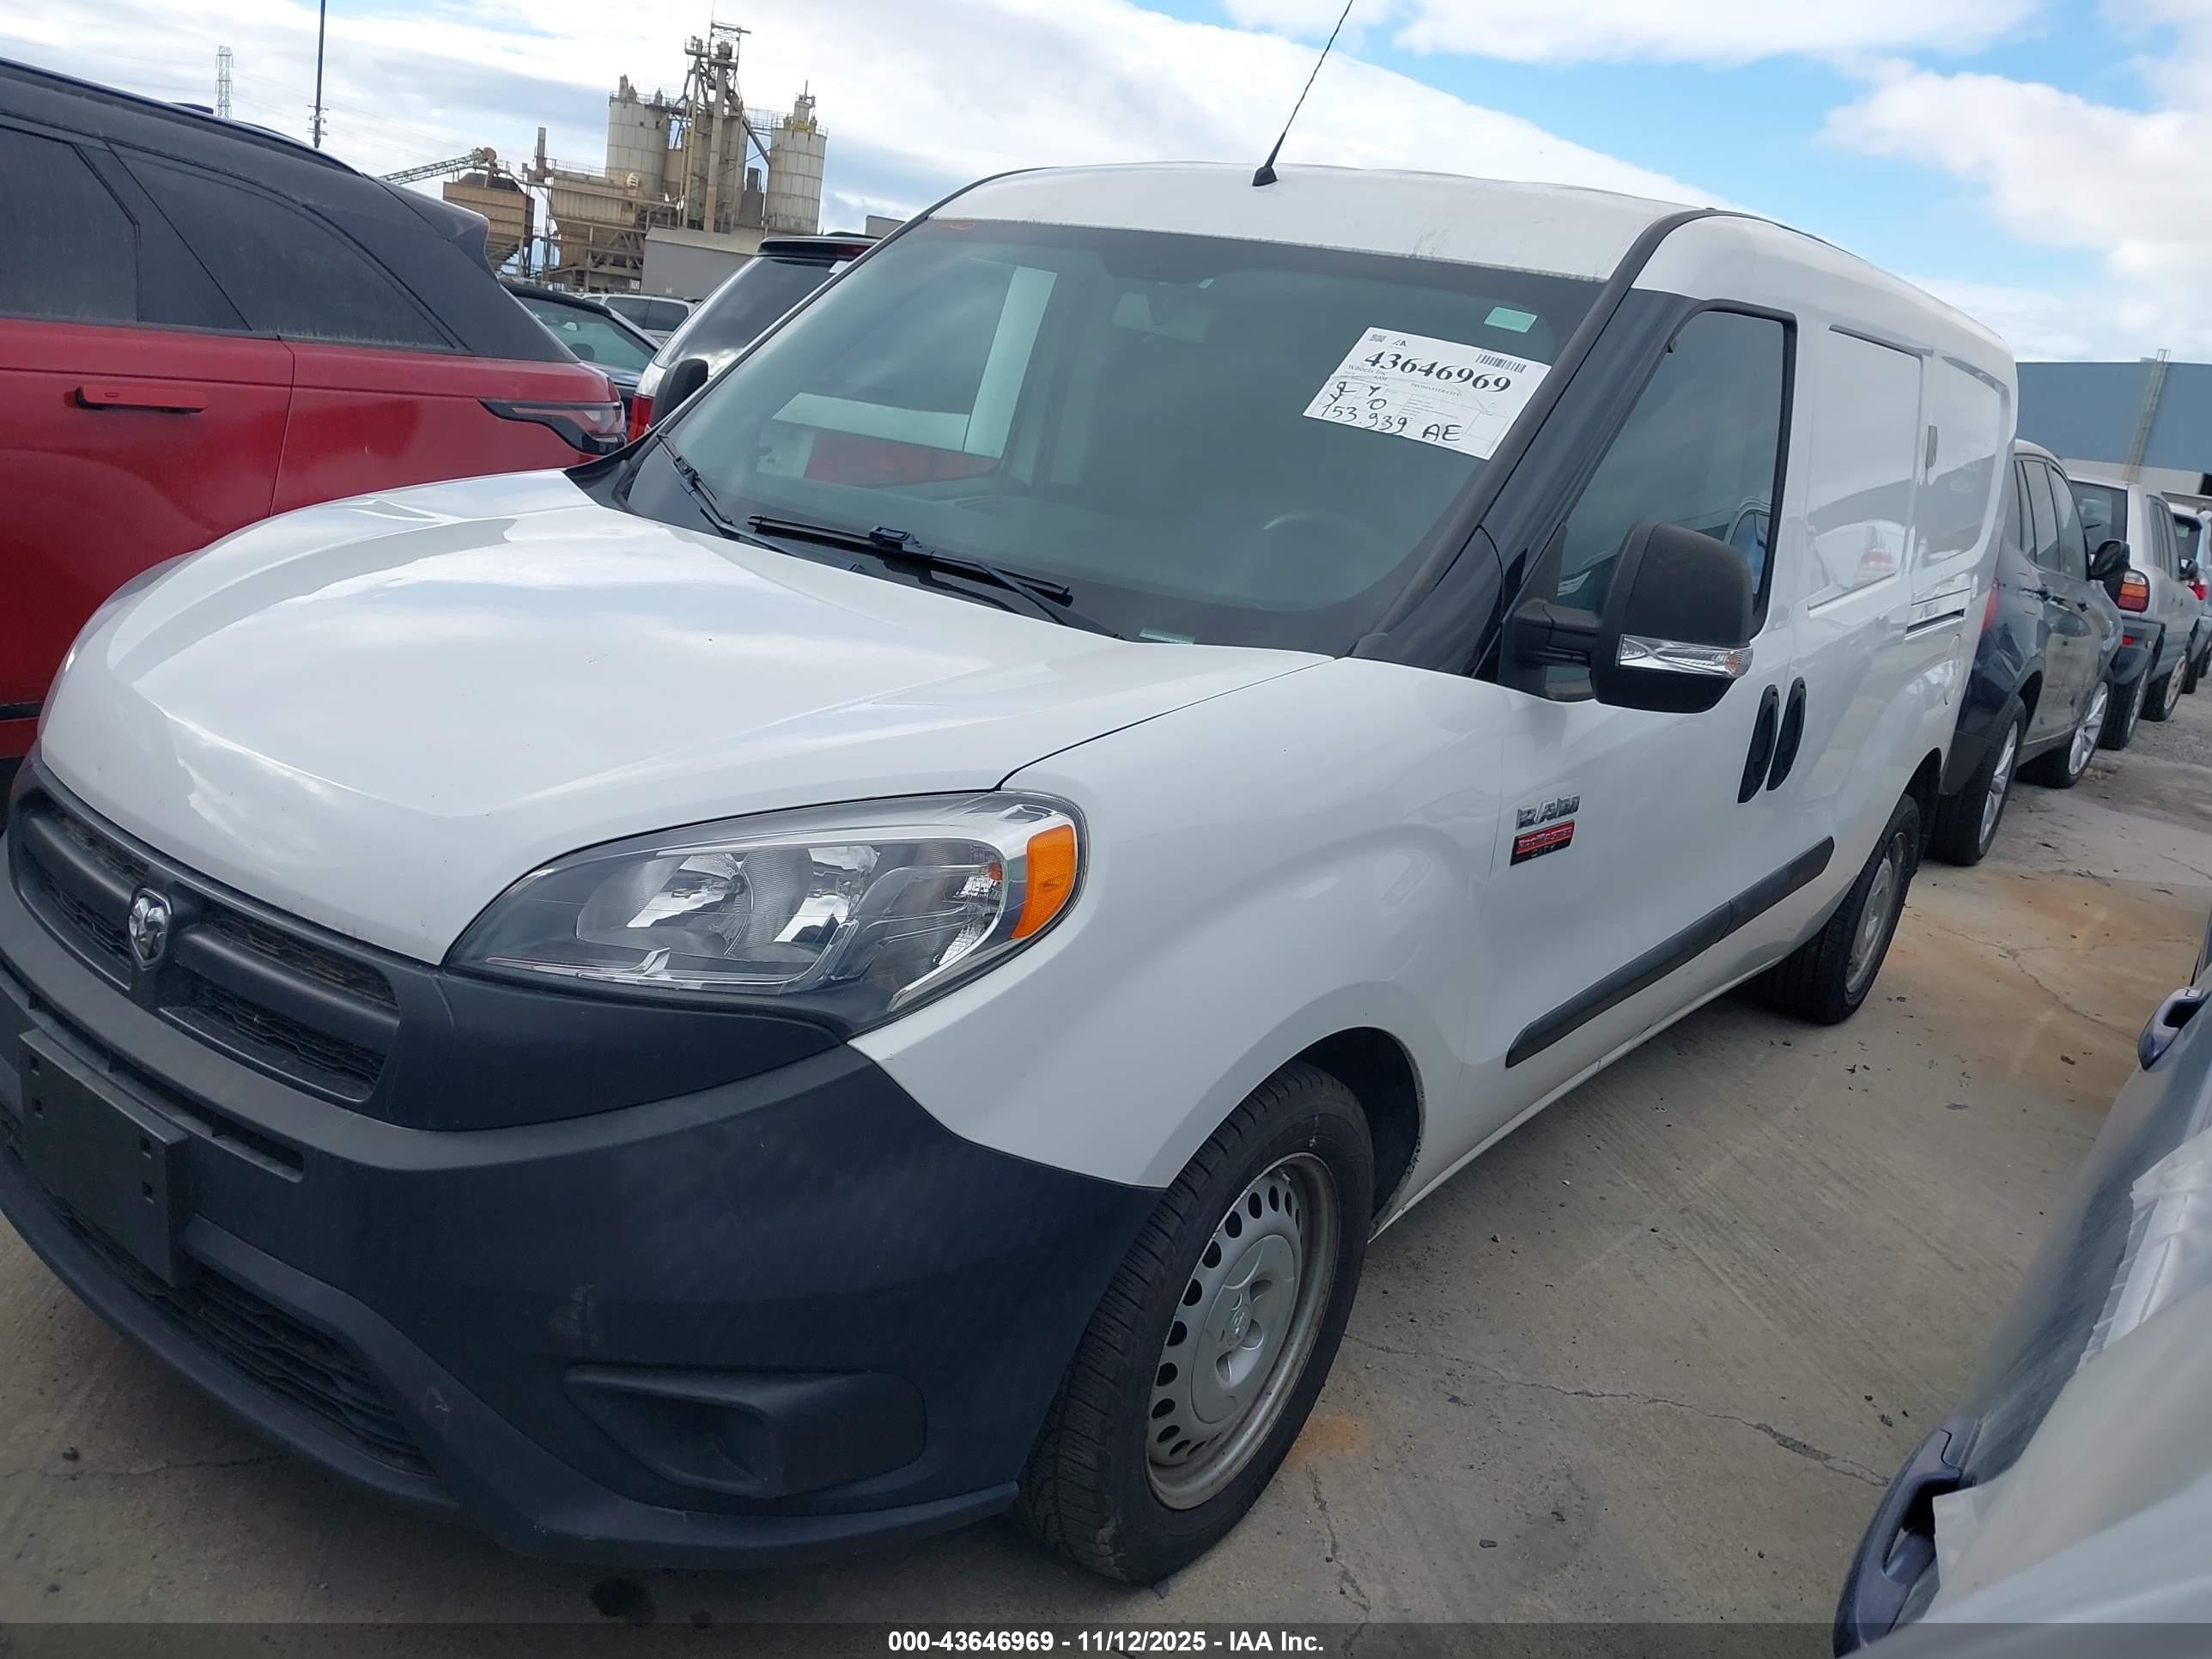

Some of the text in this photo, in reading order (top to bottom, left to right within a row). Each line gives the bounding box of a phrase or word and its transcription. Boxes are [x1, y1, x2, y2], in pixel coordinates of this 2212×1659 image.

[1364, 350, 1511, 392] 43646969
[1422, 423, 1462, 441] AE
[1516, 794, 1581, 830] RAM
